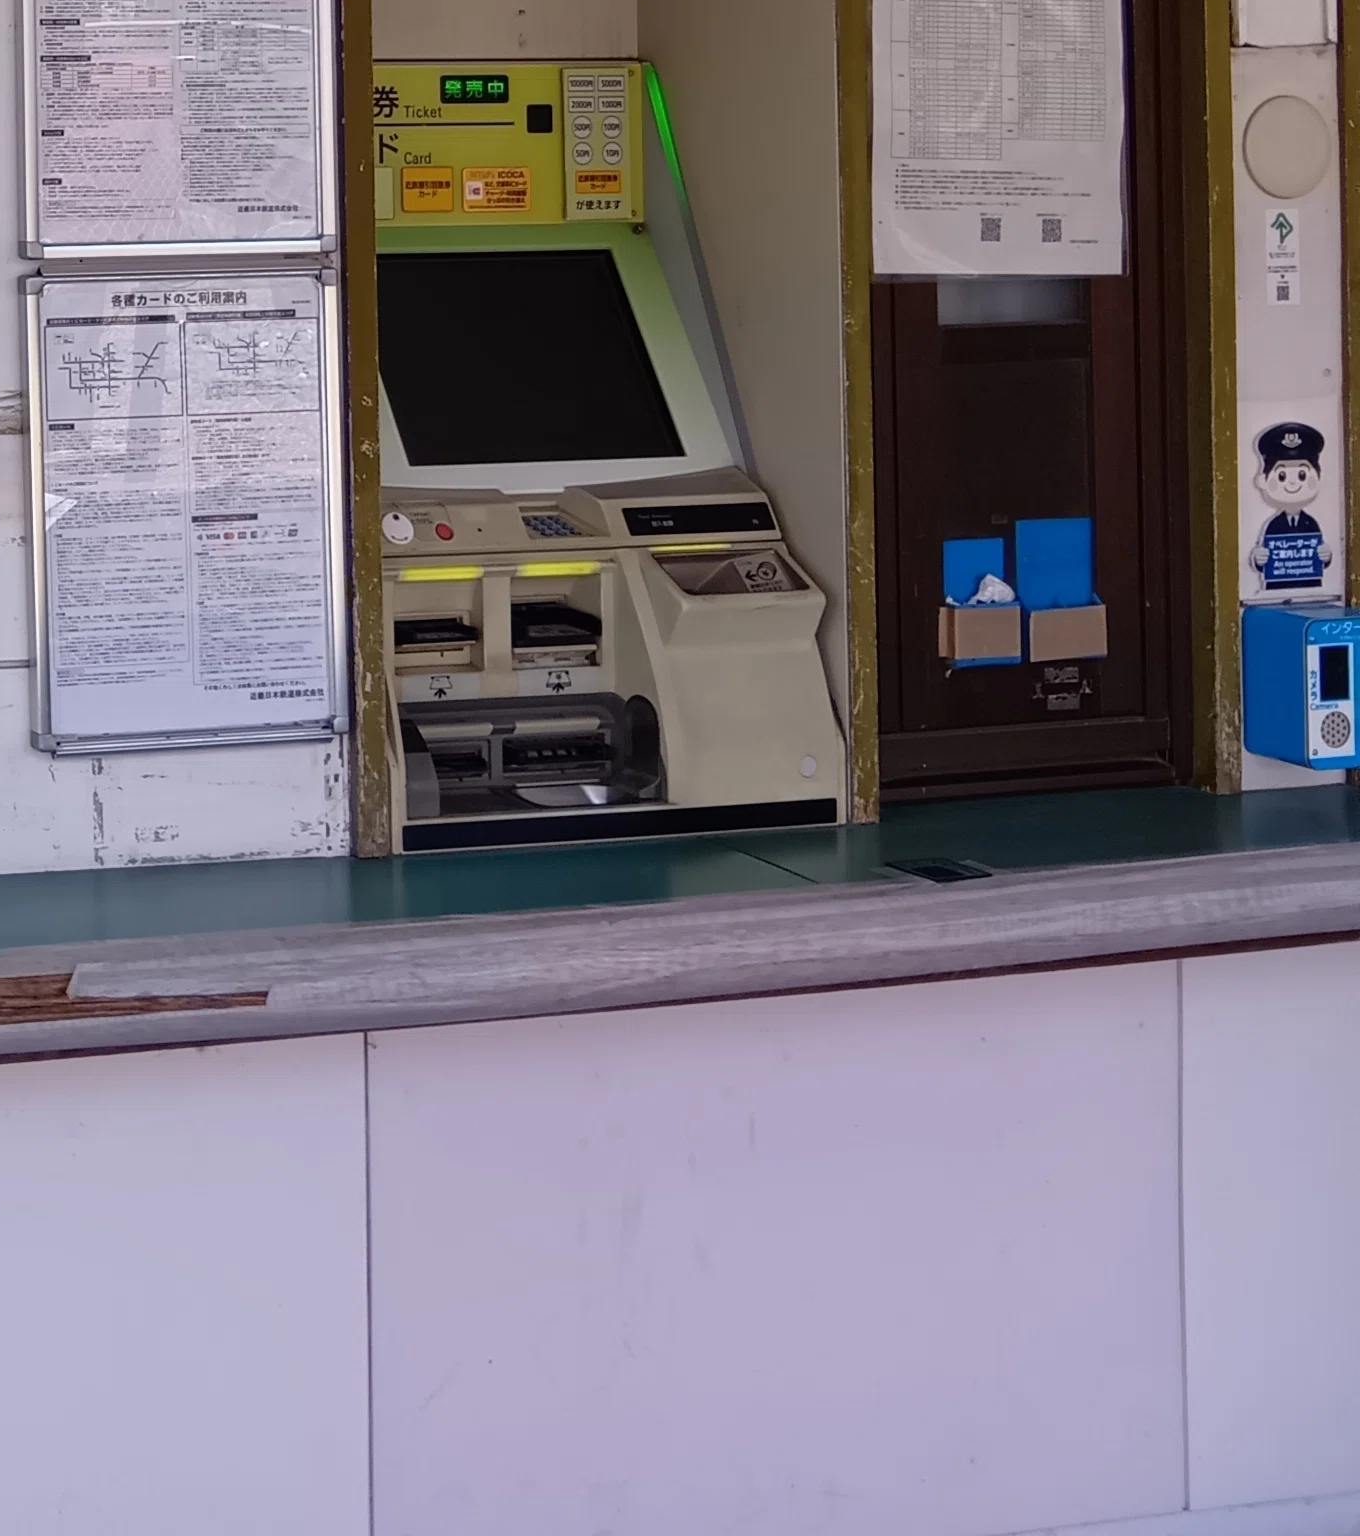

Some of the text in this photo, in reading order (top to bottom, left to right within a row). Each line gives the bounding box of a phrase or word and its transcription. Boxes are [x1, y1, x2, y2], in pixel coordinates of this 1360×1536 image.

[444, 80, 505, 99] 発売中
[373, 86, 399, 118] 券
[404, 105, 442, 119] Ticket
[404, 152, 432, 165] Card
[497, 171, 525, 179] ICOCA
[576, 199, 621, 211] が使えます
[111, 291, 247, 306] 各種カードのご利用案内
[1268, 538, 1318, 550] オペレーターが
[1272, 549, 1314, 559] ご案内します
[1310, 702, 1339, 711] Camera
